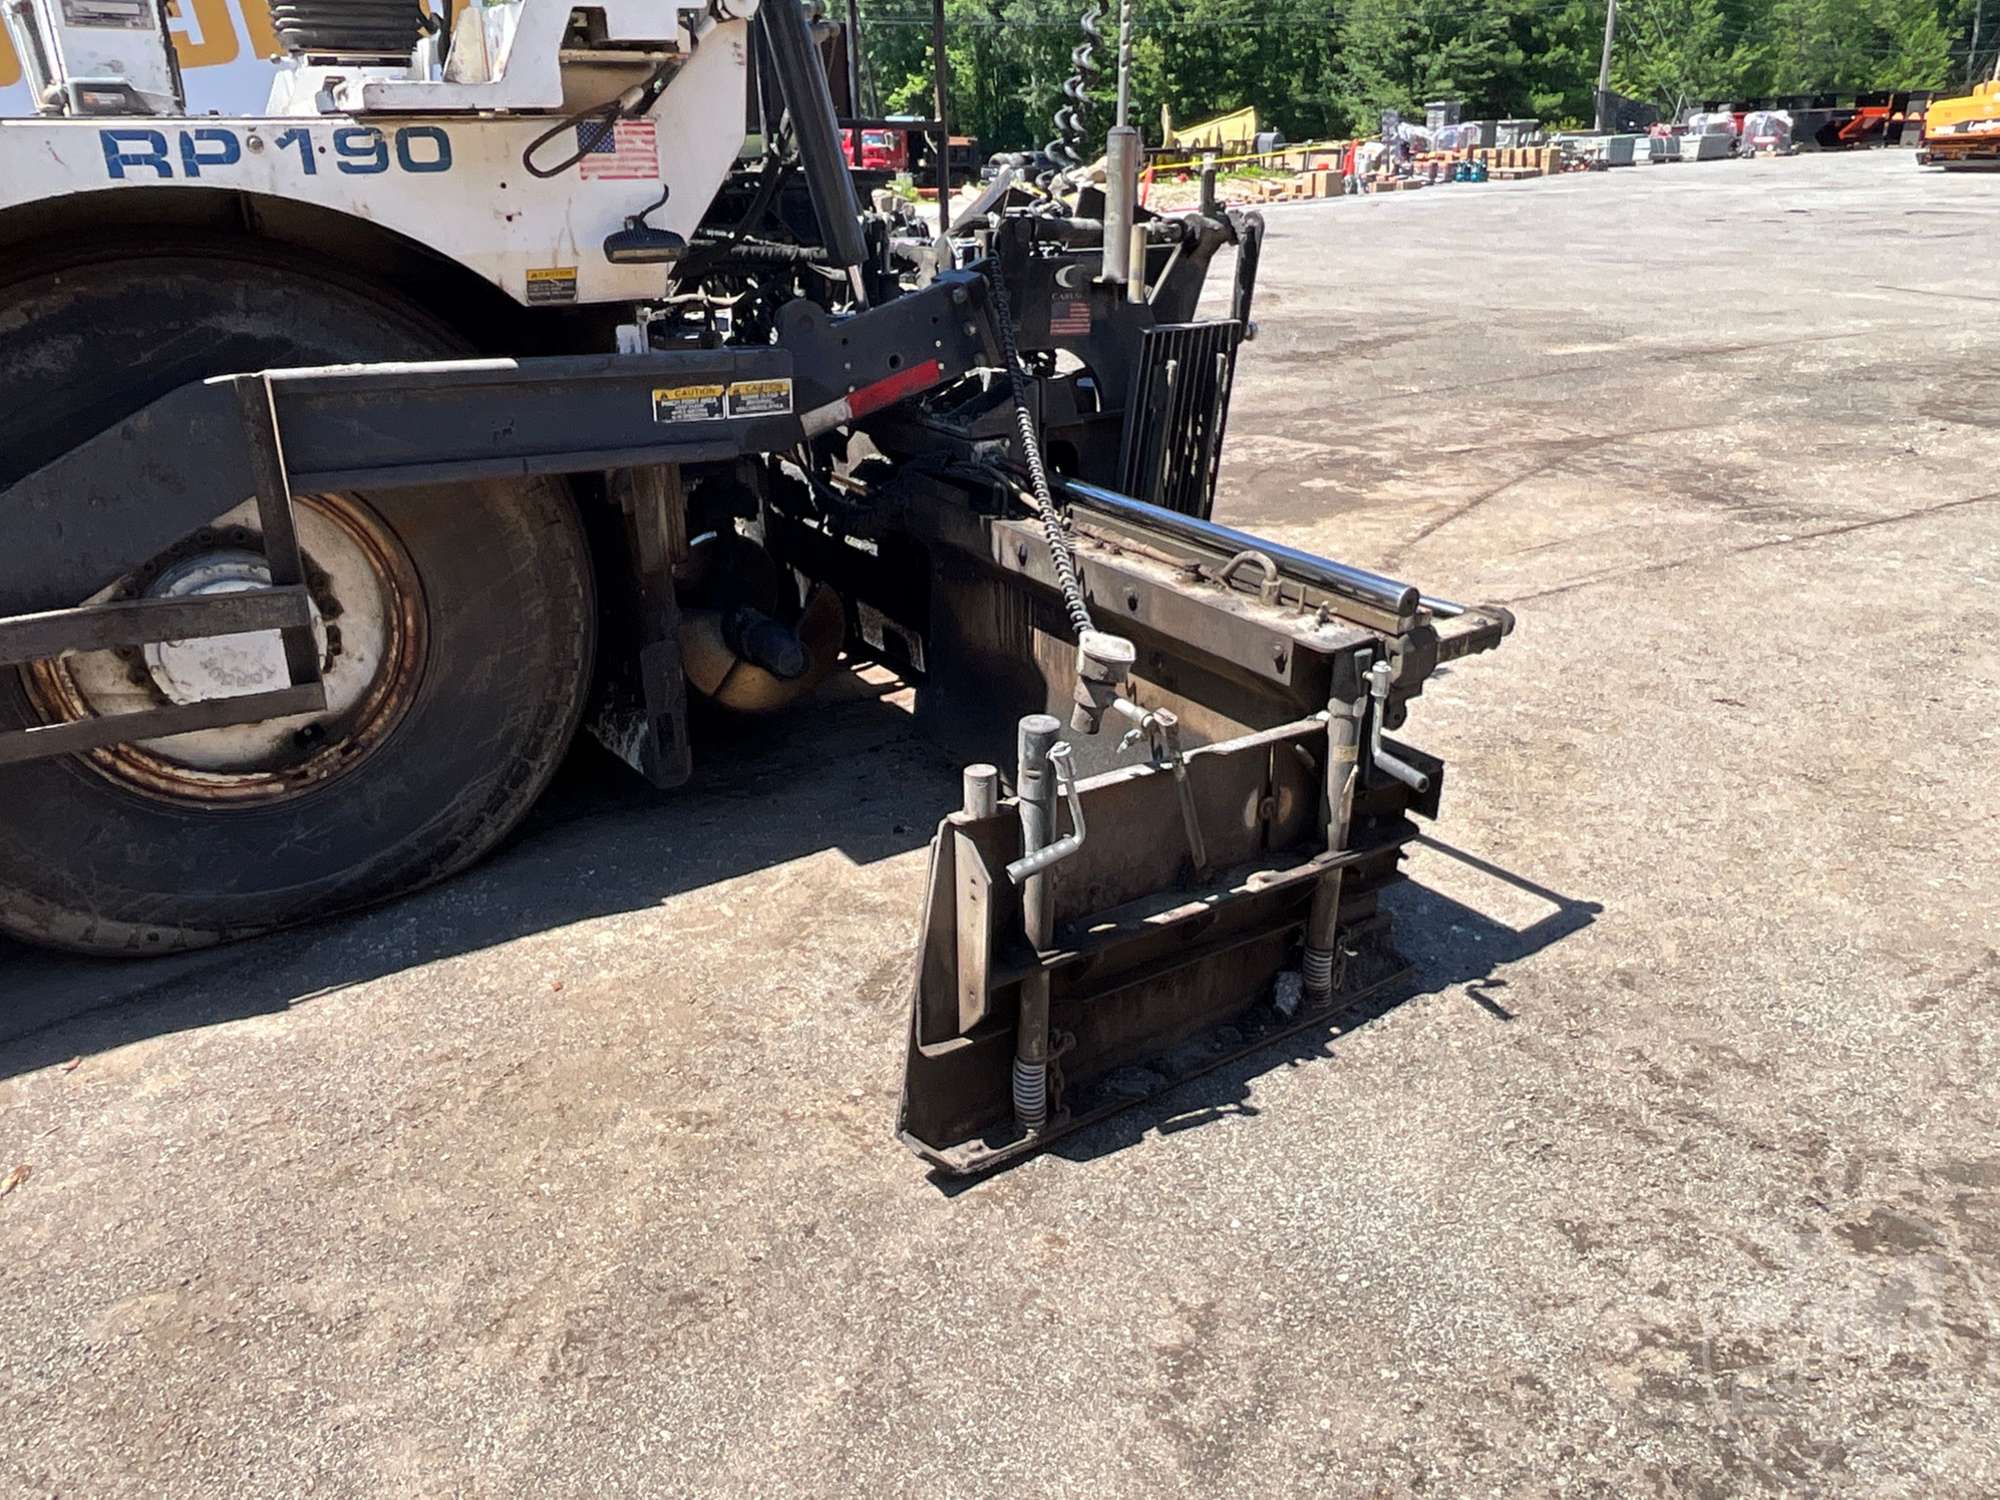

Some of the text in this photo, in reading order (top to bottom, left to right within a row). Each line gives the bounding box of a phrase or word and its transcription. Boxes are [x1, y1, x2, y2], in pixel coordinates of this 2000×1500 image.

[99, 125, 453, 180] RP 190
[673, 388, 717, 398] CAUTION
